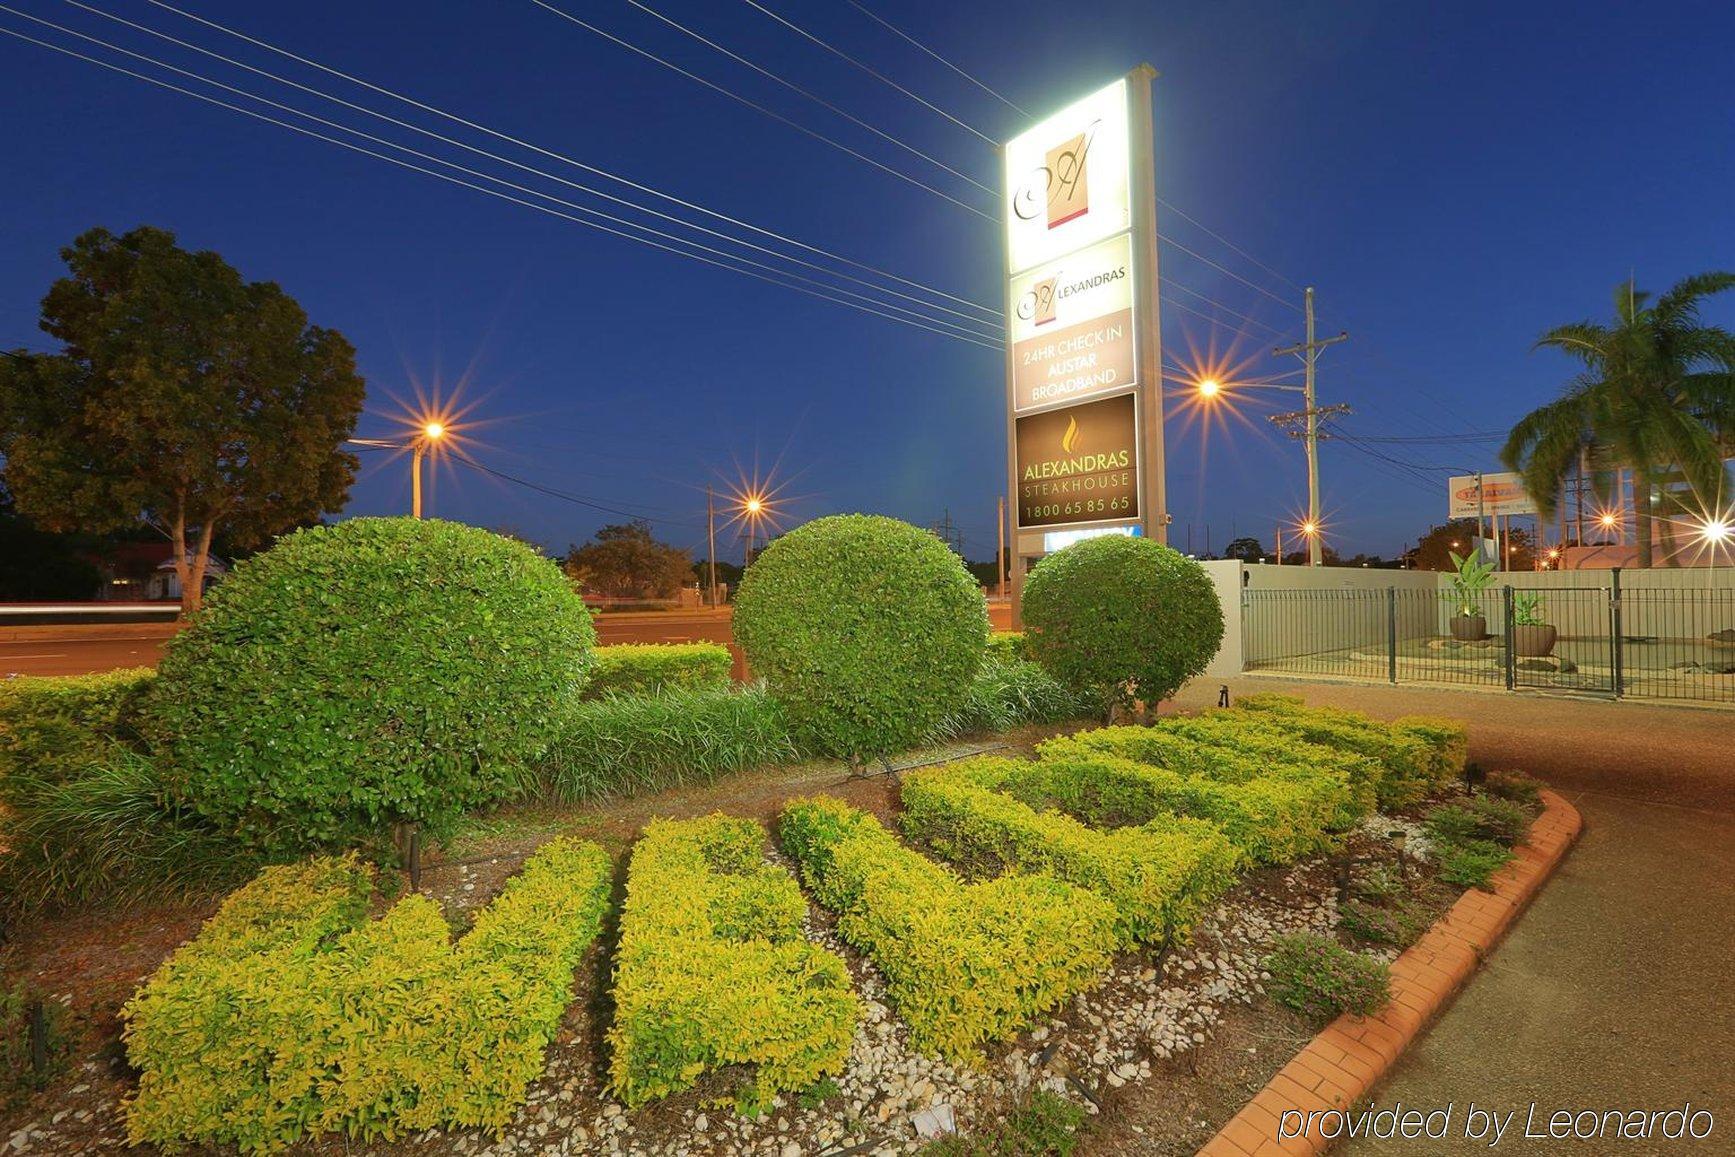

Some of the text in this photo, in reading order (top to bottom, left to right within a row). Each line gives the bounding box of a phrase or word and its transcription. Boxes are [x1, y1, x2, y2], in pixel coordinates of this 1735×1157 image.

[1023, 324, 1123, 365] 24HR CHECK IN
[1047, 352, 1098, 377] AUSTAR
[1031, 368, 1117, 401] BROADBAND
[1024, 450, 1129, 480] ALEXANDRAS
[1025, 473, 1129, 498] STEAKHOUSE
[1026, 496, 1129, 518] 1800 65 85 65
